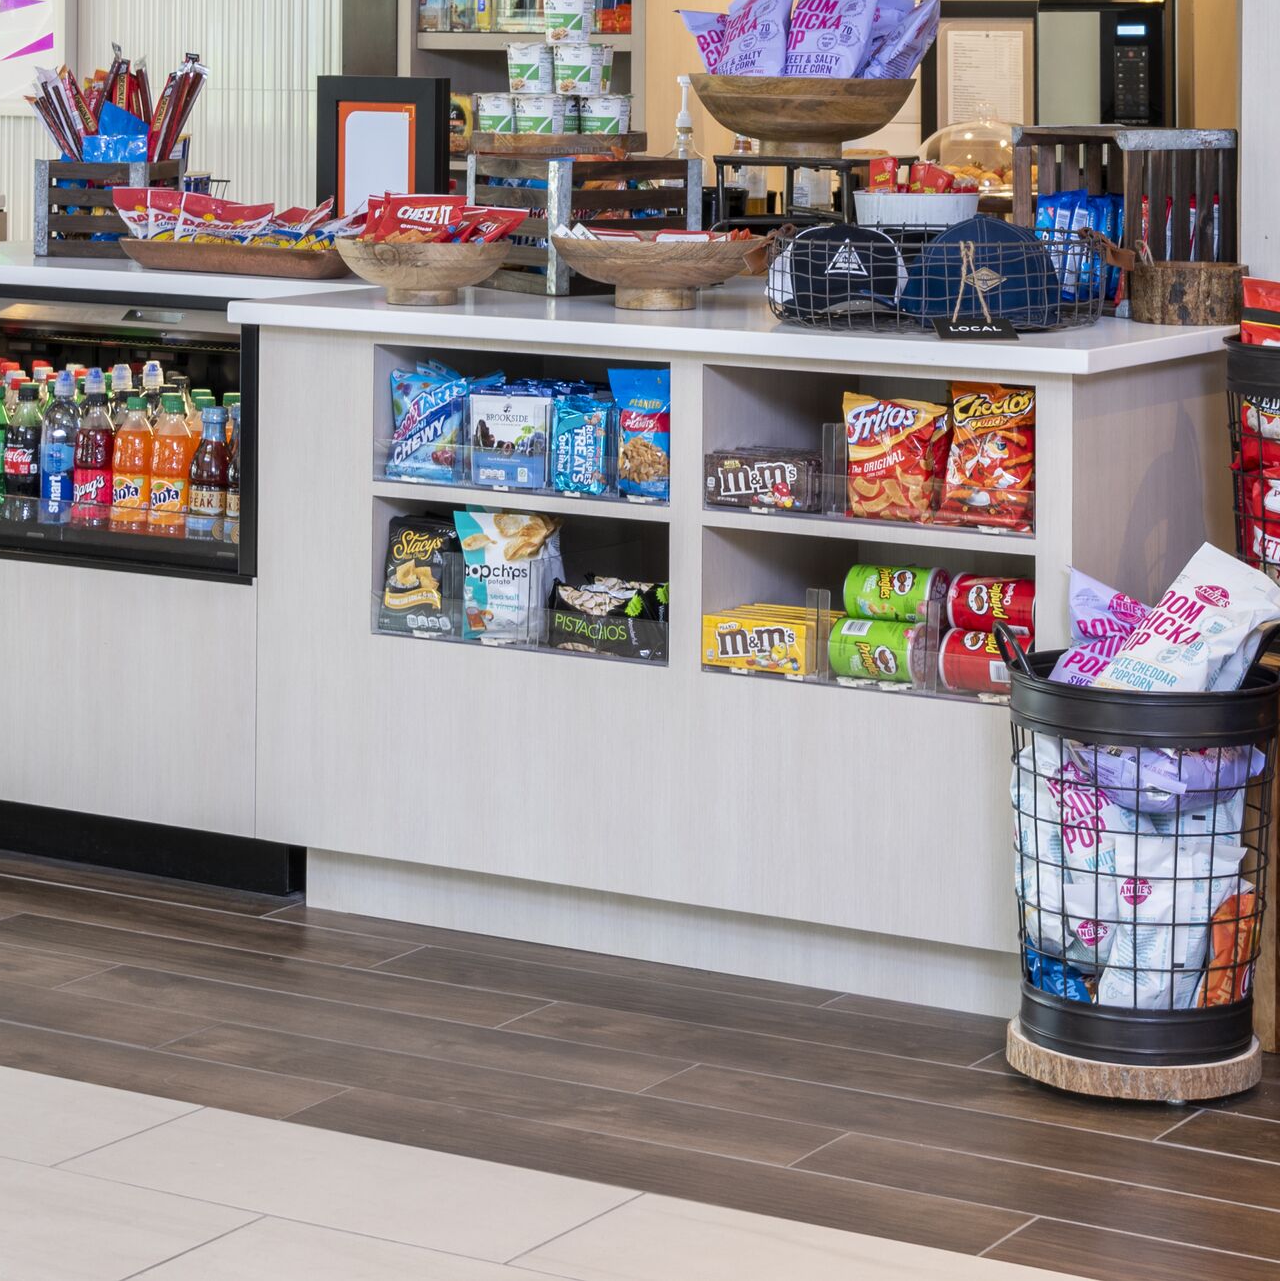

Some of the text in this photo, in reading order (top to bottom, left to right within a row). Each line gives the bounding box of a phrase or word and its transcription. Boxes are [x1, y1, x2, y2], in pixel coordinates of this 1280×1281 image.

[792, 11, 843, 30] HICKA
[784, 65, 807, 74] ETTLE
[949, 325, 1003, 333] LOCAL
[486, 413, 529, 423] BROOKSIDE
[953, 391, 1035, 423] Cheetos
[585, 424, 593, 445] RICE
[847, 400, 918, 444] Fritos
[393, 415, 446, 465] CHEWY
[572, 426, 586, 482] TREATS
[863, 449, 906, 474] ORIGINAL
[73, 474, 105, 503] Barq's
[112, 481, 140, 501] anta
[151, 486, 181, 506] anta
[190, 497, 213, 508] PEAK
[394, 530, 444, 560] Stacy's
[988, 583, 1009, 619] Pringles
[1107, 600, 1146, 618] ANGIE'S
[1158, 590, 1206, 625] OOM
[1194, 585, 1232, 609] ANGIE'S
[554, 613, 627, 641] PISTACHIOS
[1138, 610, 1202, 645] HICKA
[715, 626, 796, 659] m&m's
[1110, 667, 1154, 691] POPCORN
[1131, 659, 1177, 687] CHEDDAR
